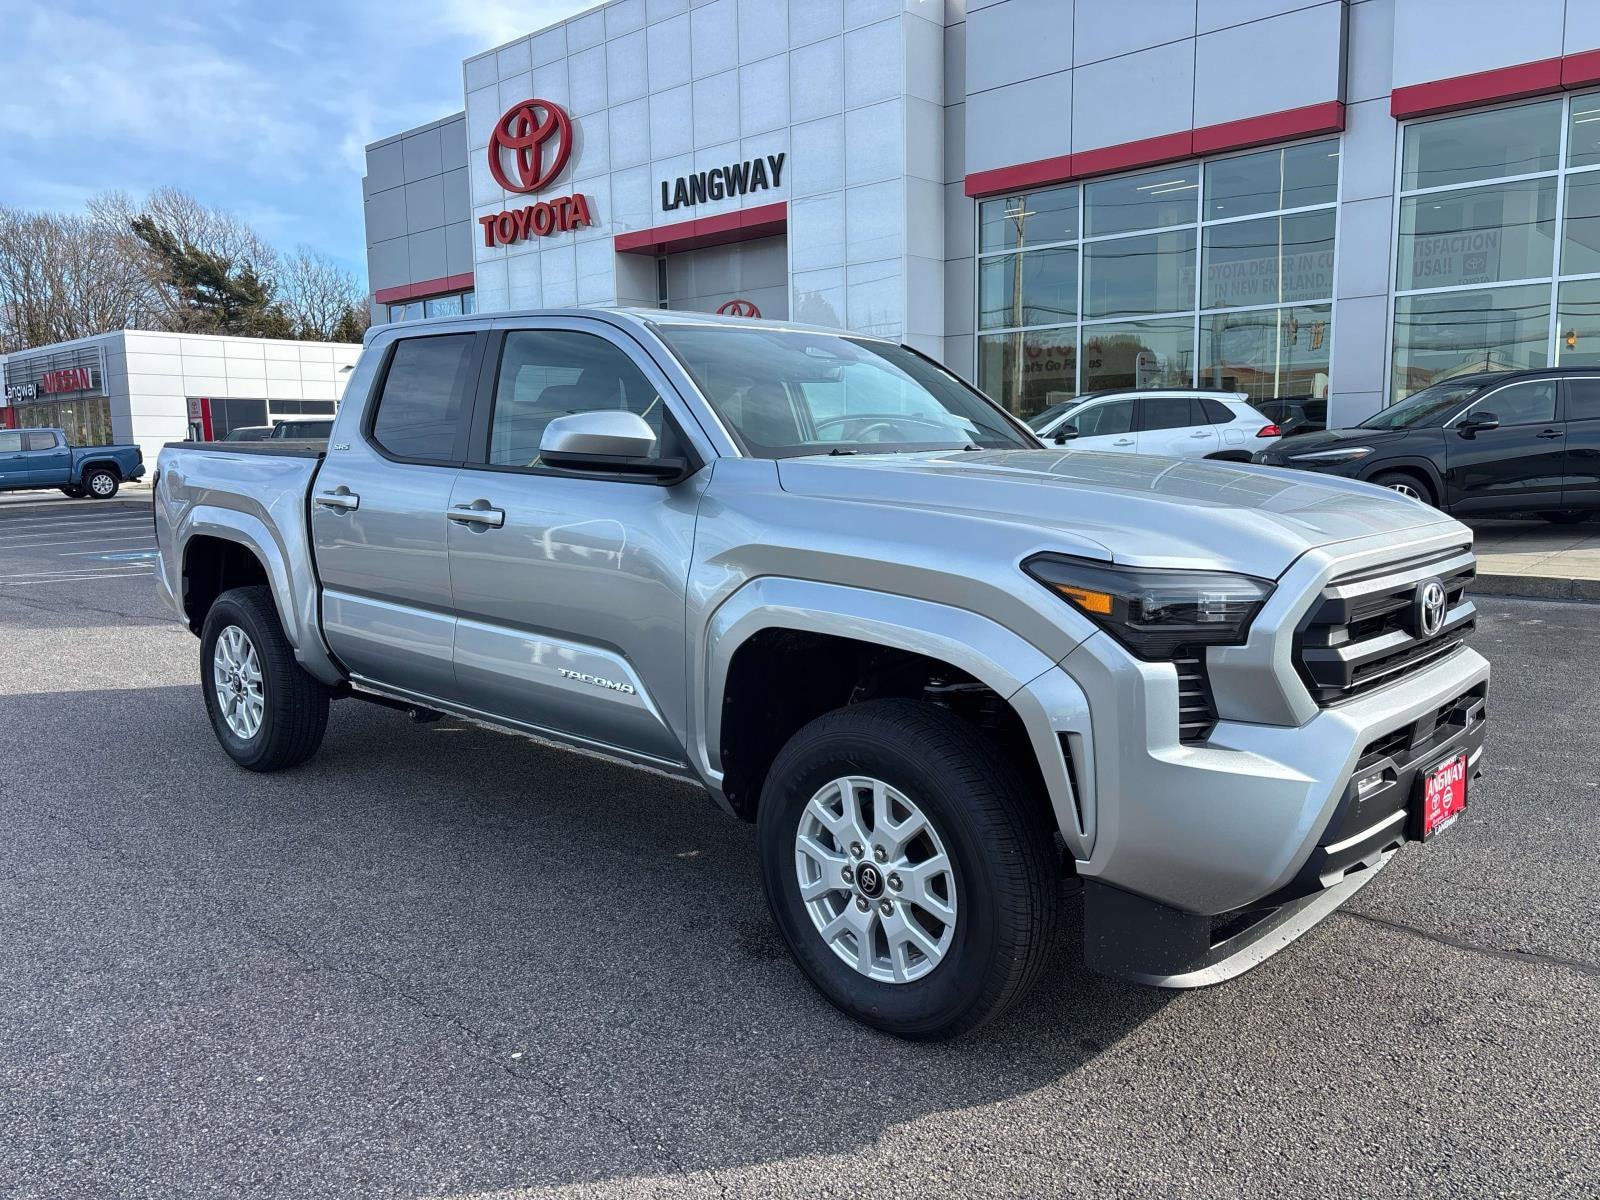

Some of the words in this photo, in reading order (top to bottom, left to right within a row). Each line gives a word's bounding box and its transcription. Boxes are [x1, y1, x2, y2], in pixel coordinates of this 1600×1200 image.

[661, 152, 786, 211] LANGWAY
[479, 193, 593, 247] TOYOTA
[1208, 264, 1247, 281] OYOTA
[1298, 254, 1312, 271] IN
[1215, 284, 1228, 298] IN
[1231, 279, 1258, 297] NEW
[1045, 359, 1061, 371] Go
[4, 383, 38, 402] Langway
[43, 367, 93, 394] NISSAN
[558, 668, 636, 695] TACOMA
